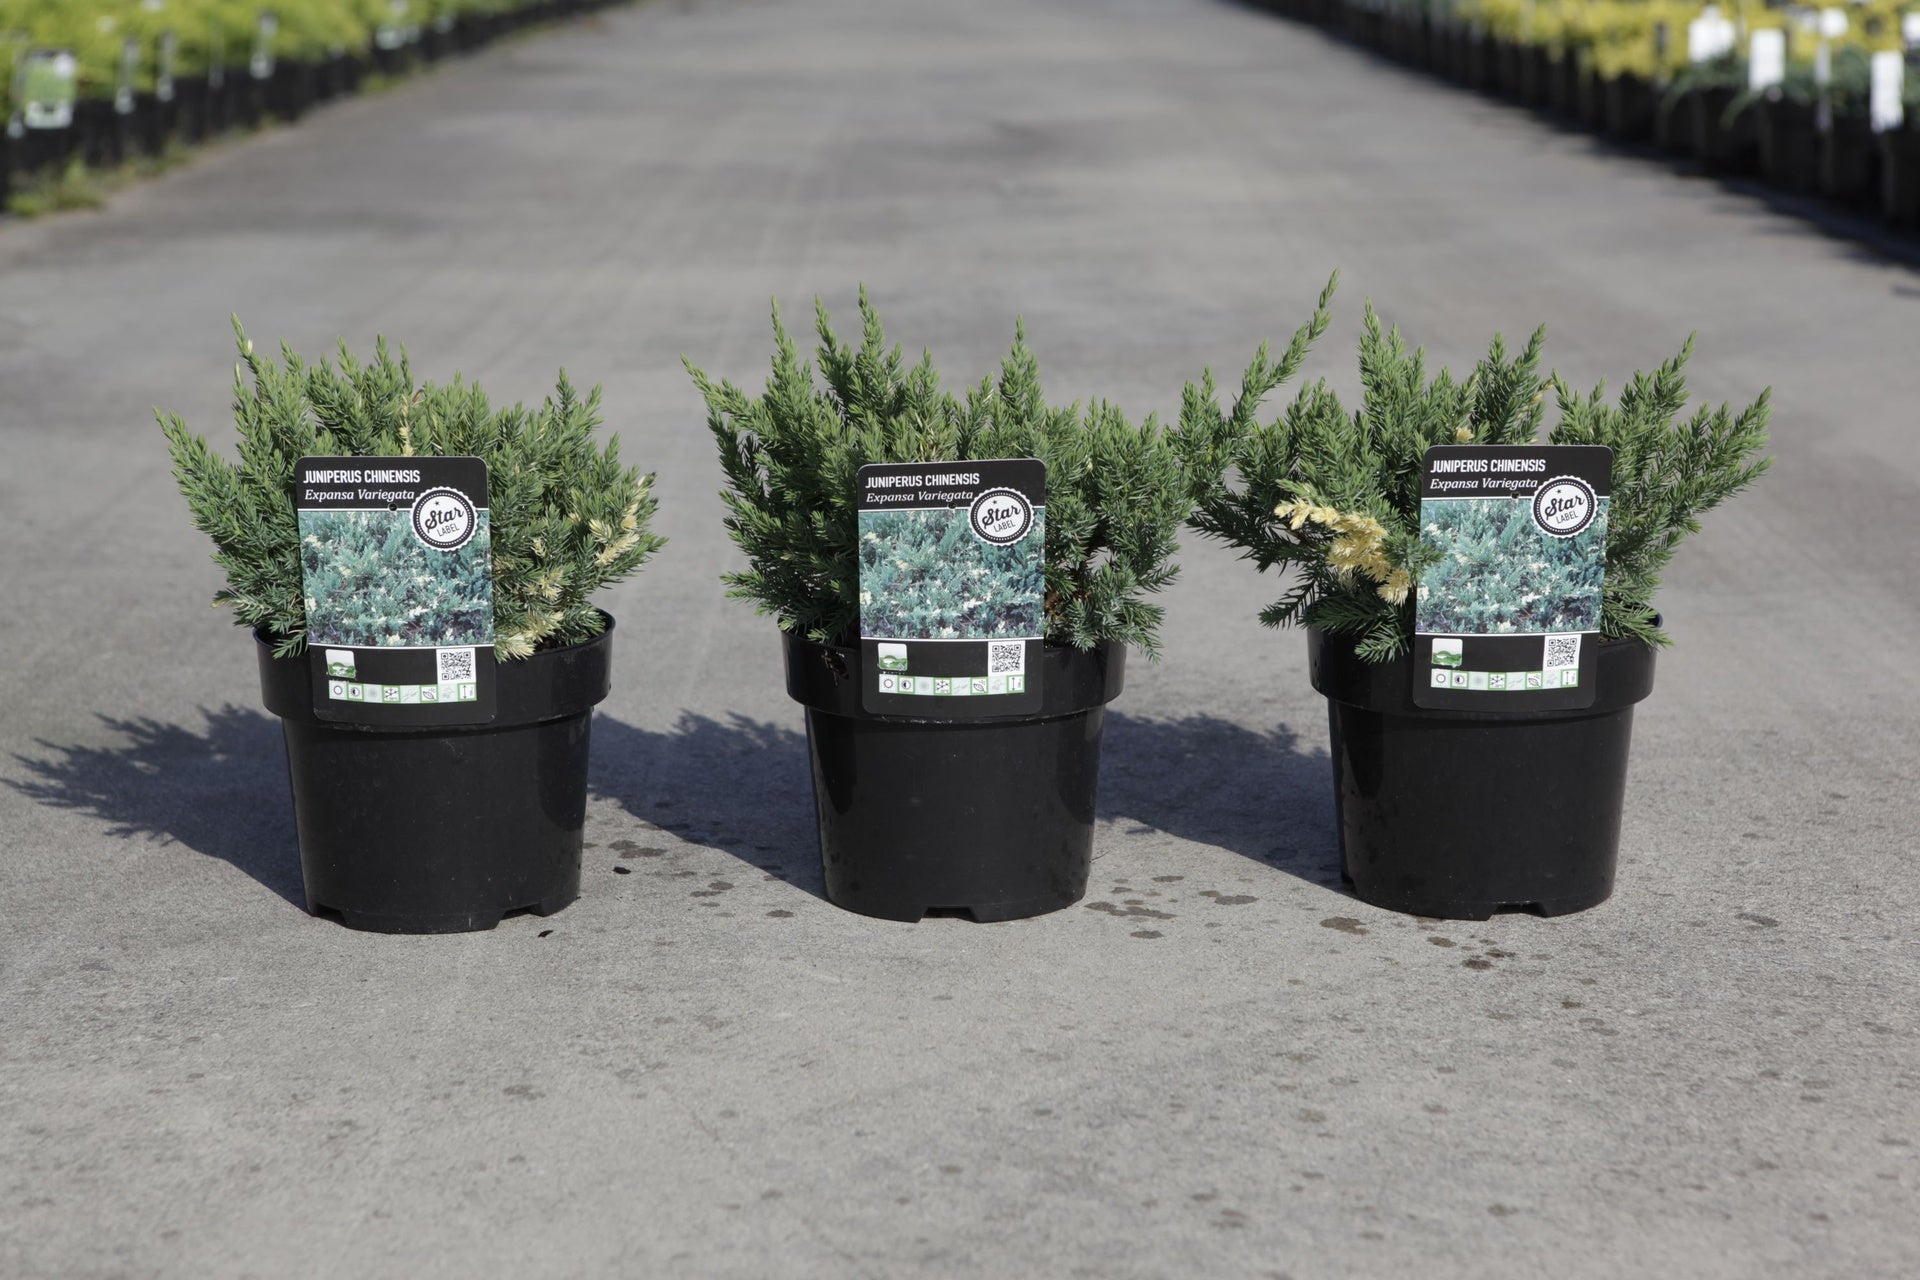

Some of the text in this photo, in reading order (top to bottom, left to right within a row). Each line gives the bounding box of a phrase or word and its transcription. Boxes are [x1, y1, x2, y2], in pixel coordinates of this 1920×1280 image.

[1430, 459, 1546, 473] JUNIPERUS CHINENSIS
[303, 470, 420, 484] JUNIPERUS CHINENSIS
[865, 473, 980, 488] JUNIPERUS CHINENSIS
[1430, 478, 1538, 491] Expansa Variegata
[305, 489, 414, 502] Expansa Variegata
[866, 491, 973, 504] Expansa Variegata
[1544, 494, 1585, 520] Star
[425, 506, 464, 533] Star
[982, 504, 1022, 528] Star
[1556, 512, 1578, 524] LABEL
[436, 523, 460, 537] LABEL
[993, 520, 1015, 532] LABEL
